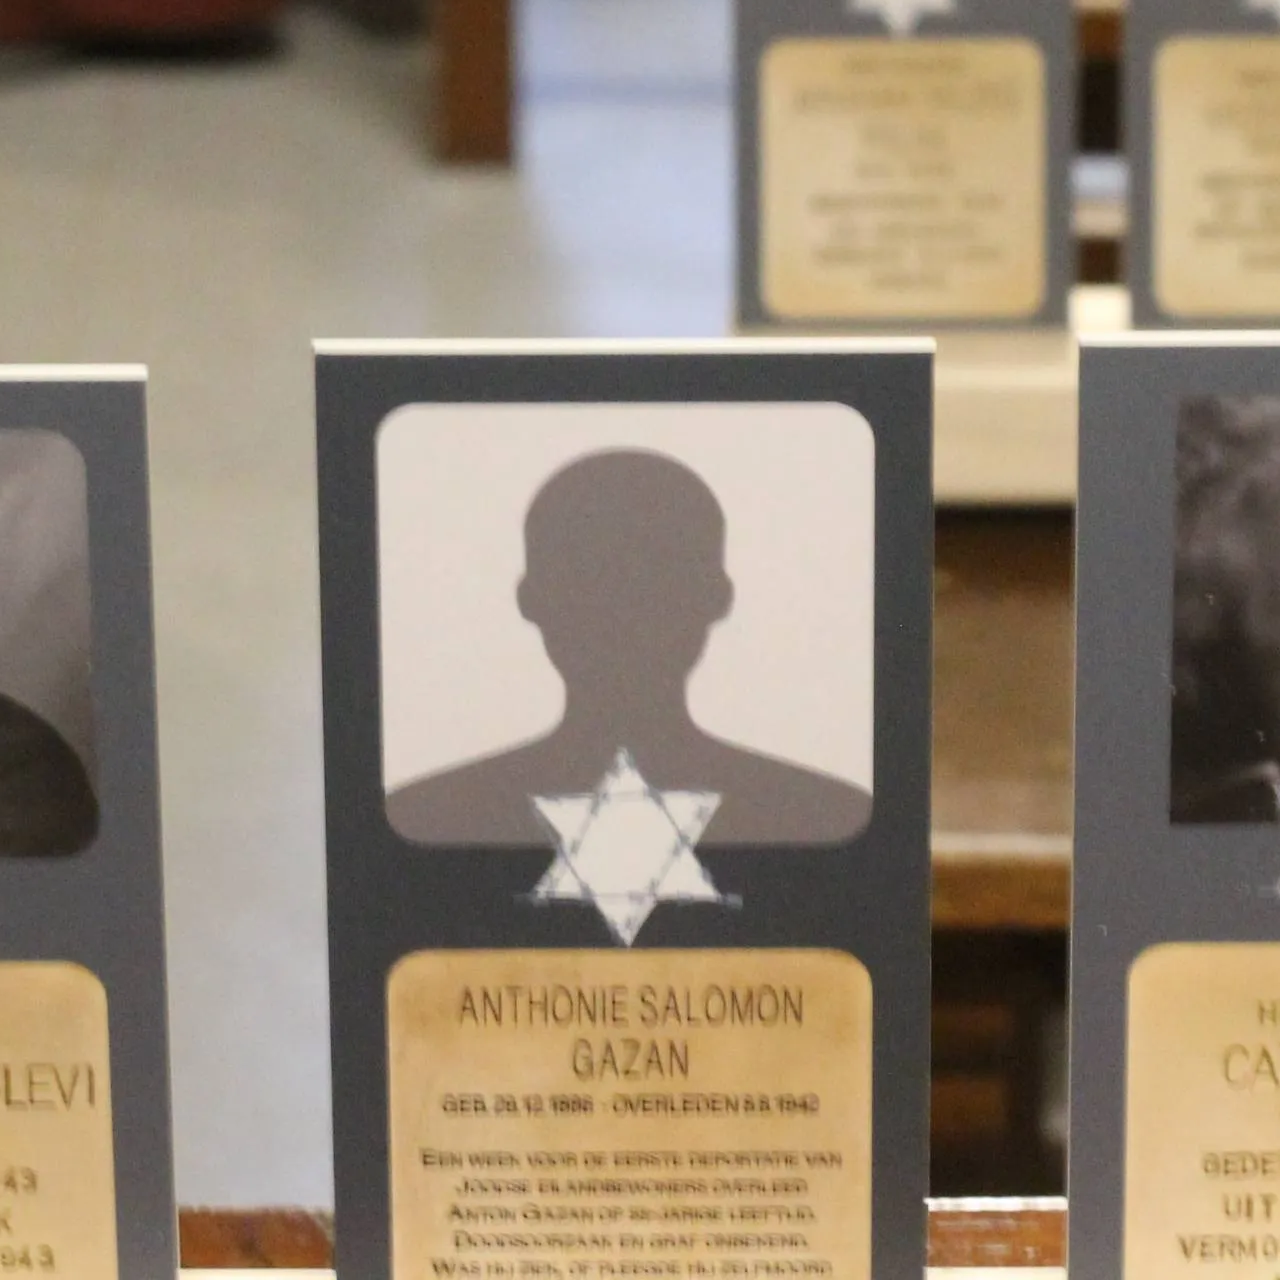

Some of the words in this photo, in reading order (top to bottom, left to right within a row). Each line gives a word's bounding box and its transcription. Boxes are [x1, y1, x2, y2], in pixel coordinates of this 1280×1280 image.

[459, 984, 629, 1028] ANTHONIE
[639, 983, 804, 1028] SALOMON
[571, 1038, 689, 1082] GAZAN
[613, 1093, 739, 1117] OVERLEDEN
[1222, 1193, 1277, 1222] UIT
